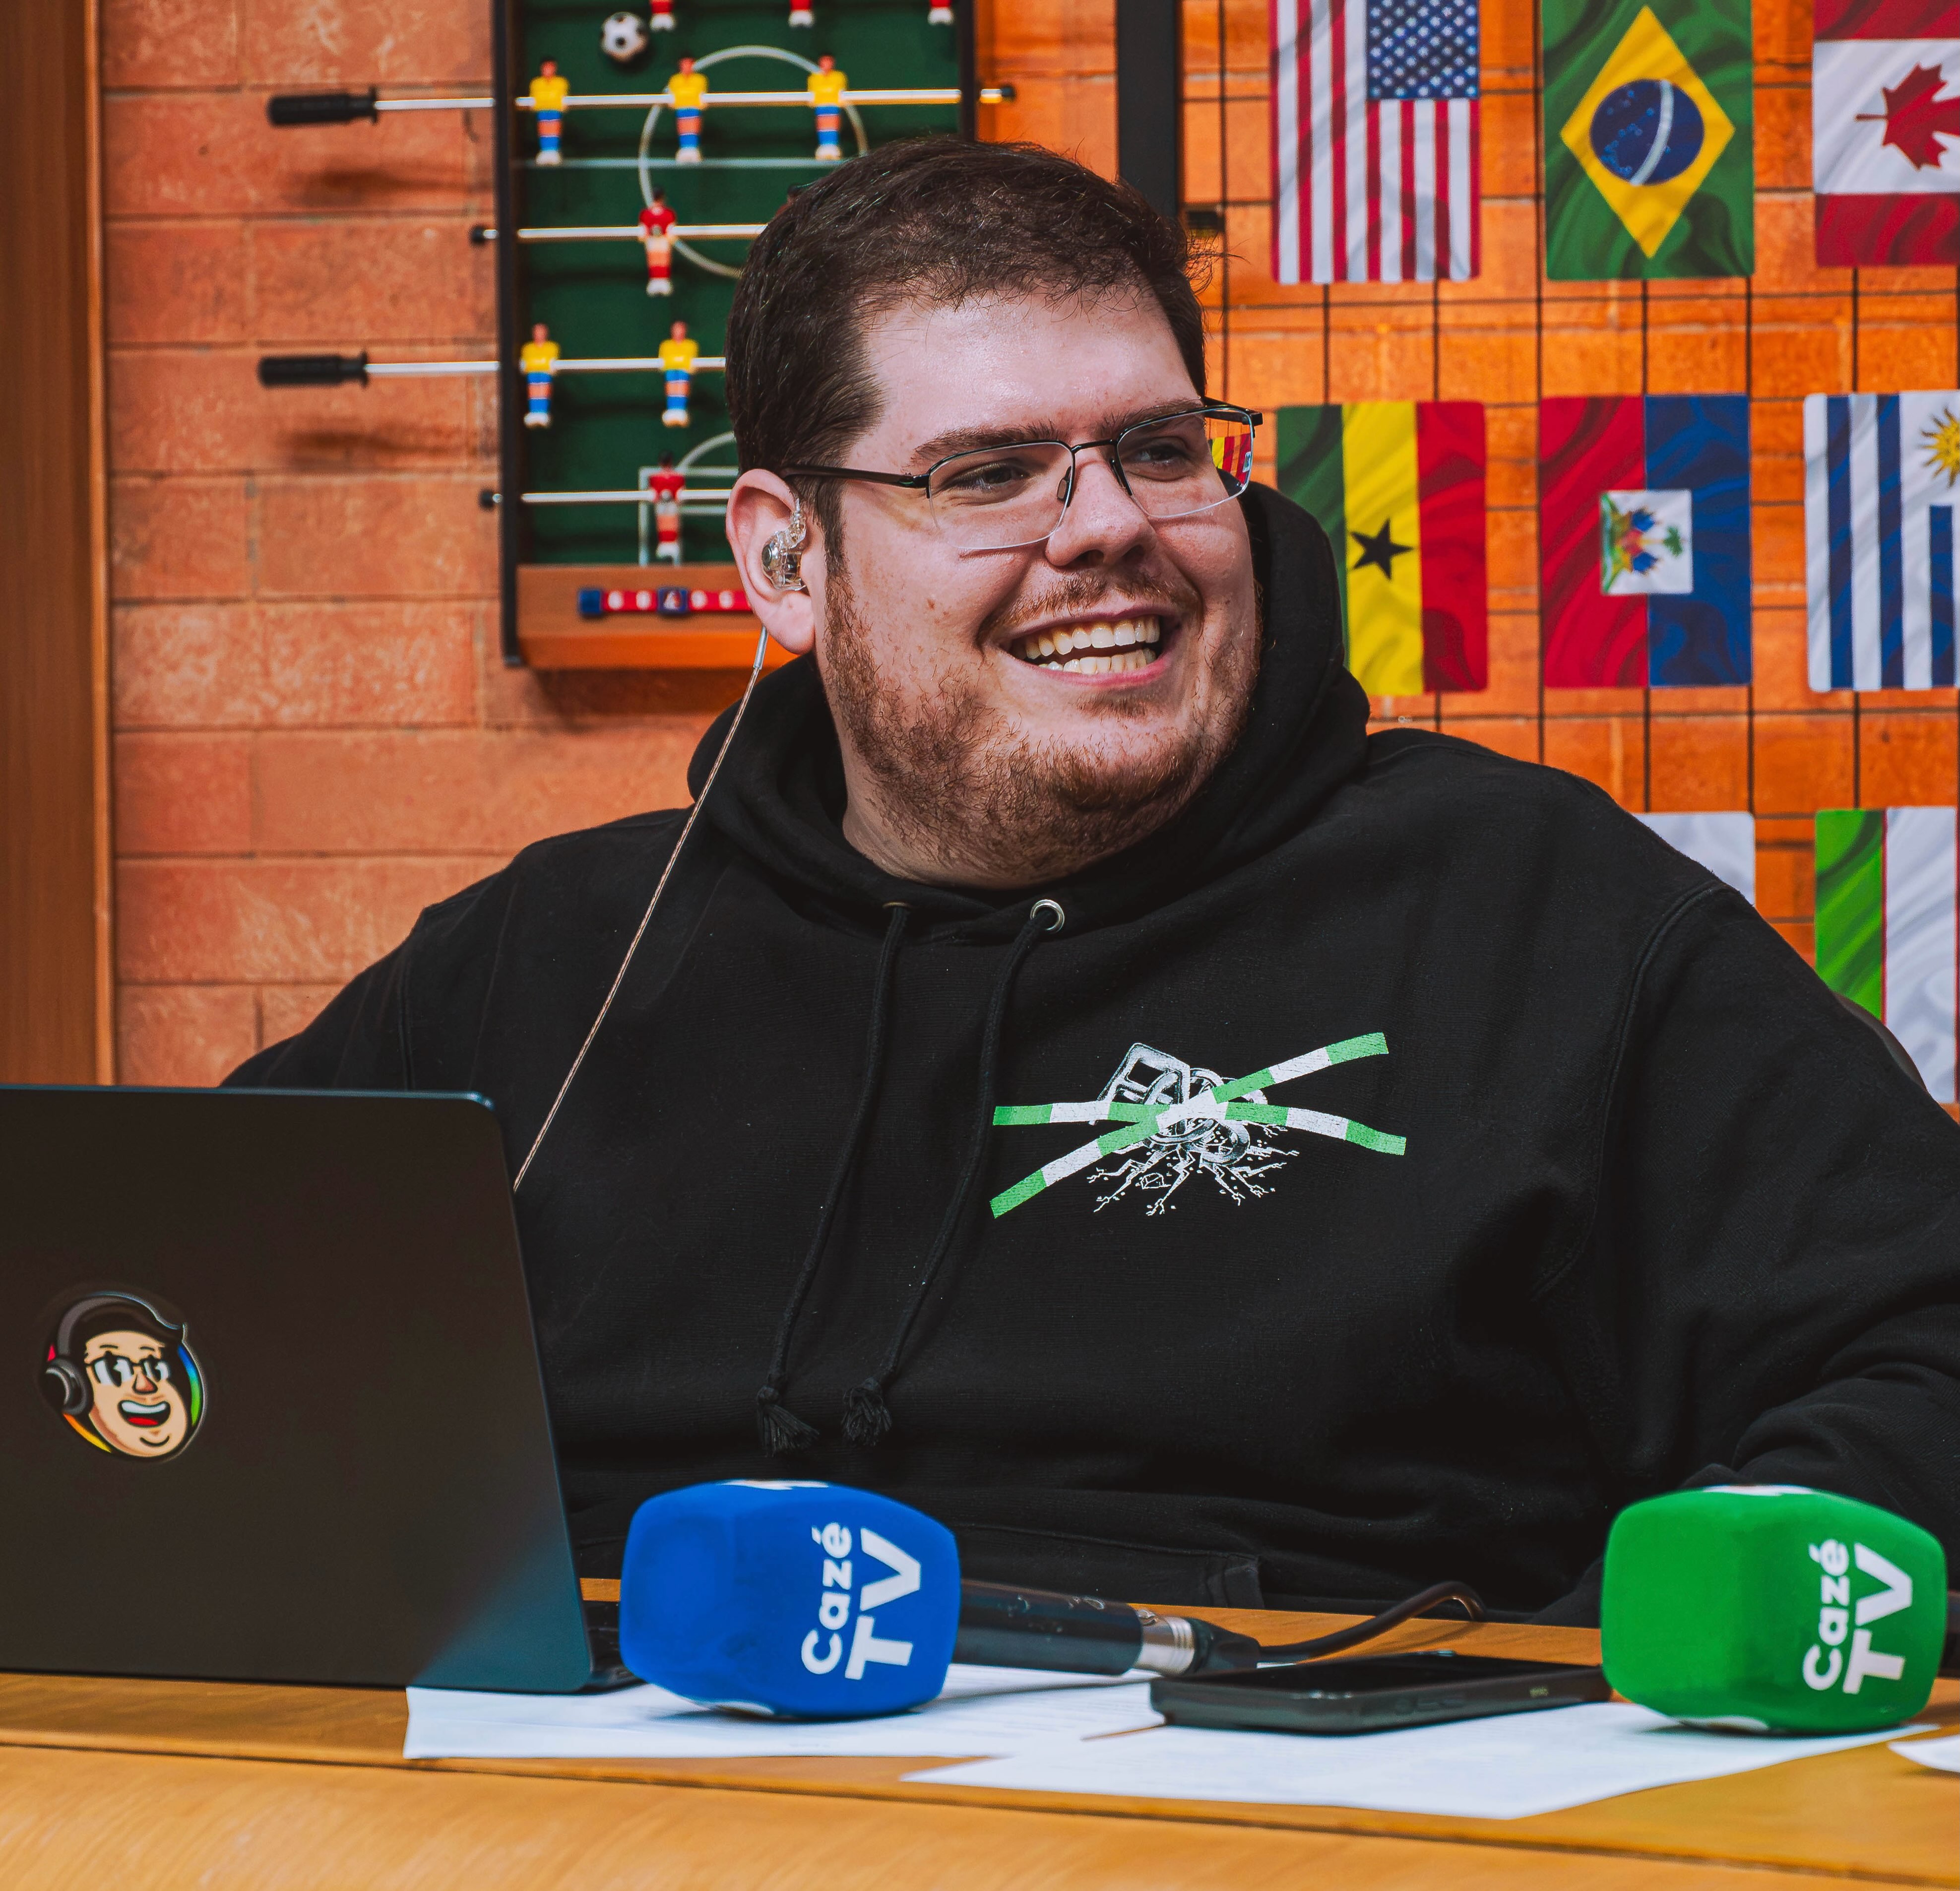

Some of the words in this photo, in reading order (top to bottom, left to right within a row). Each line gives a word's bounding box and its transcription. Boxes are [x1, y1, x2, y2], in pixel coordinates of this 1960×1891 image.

[802, 1523, 852, 1674] Cazé
[845, 1528, 921, 1680] TV
[1803, 1540, 1849, 1690] Cazé
[1843, 1544, 1912, 1694] TV
